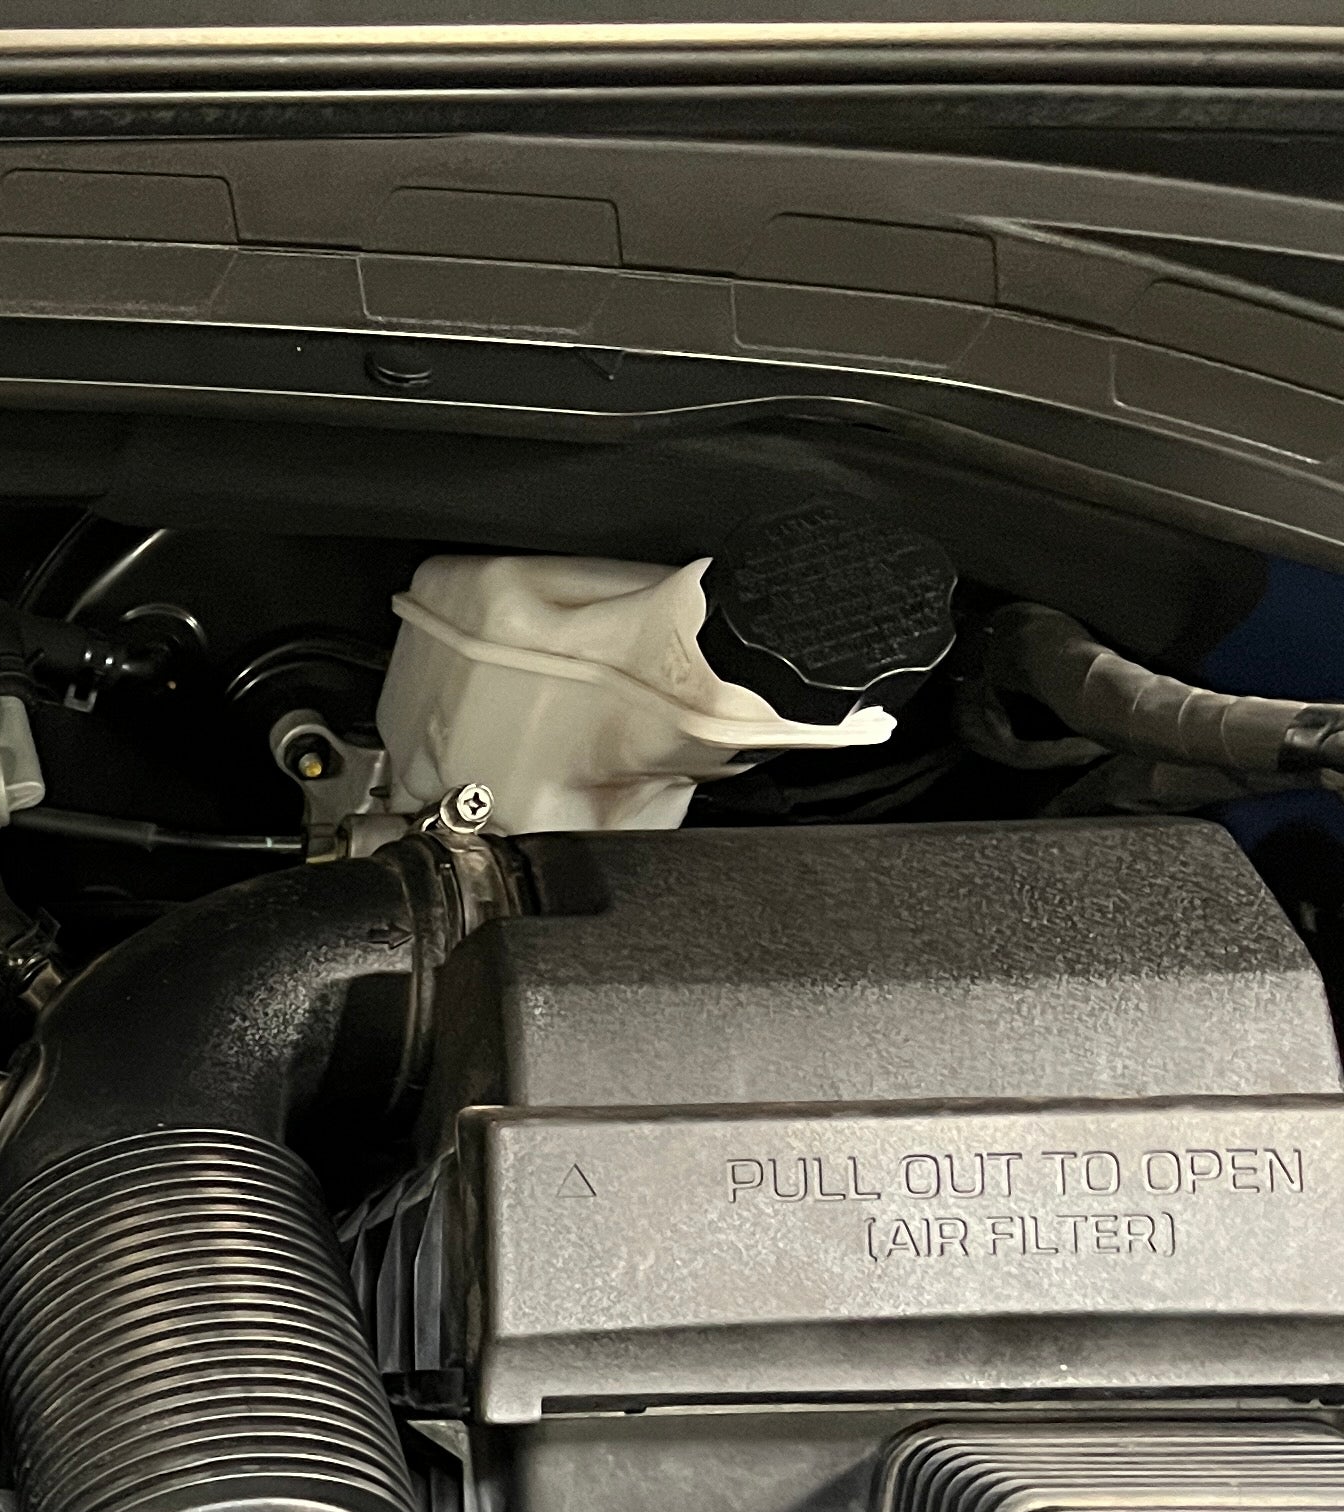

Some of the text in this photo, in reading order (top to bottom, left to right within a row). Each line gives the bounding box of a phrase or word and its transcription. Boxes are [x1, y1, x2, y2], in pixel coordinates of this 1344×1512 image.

[725, 1147, 1306, 1204] PULL OUT TO OPEN
